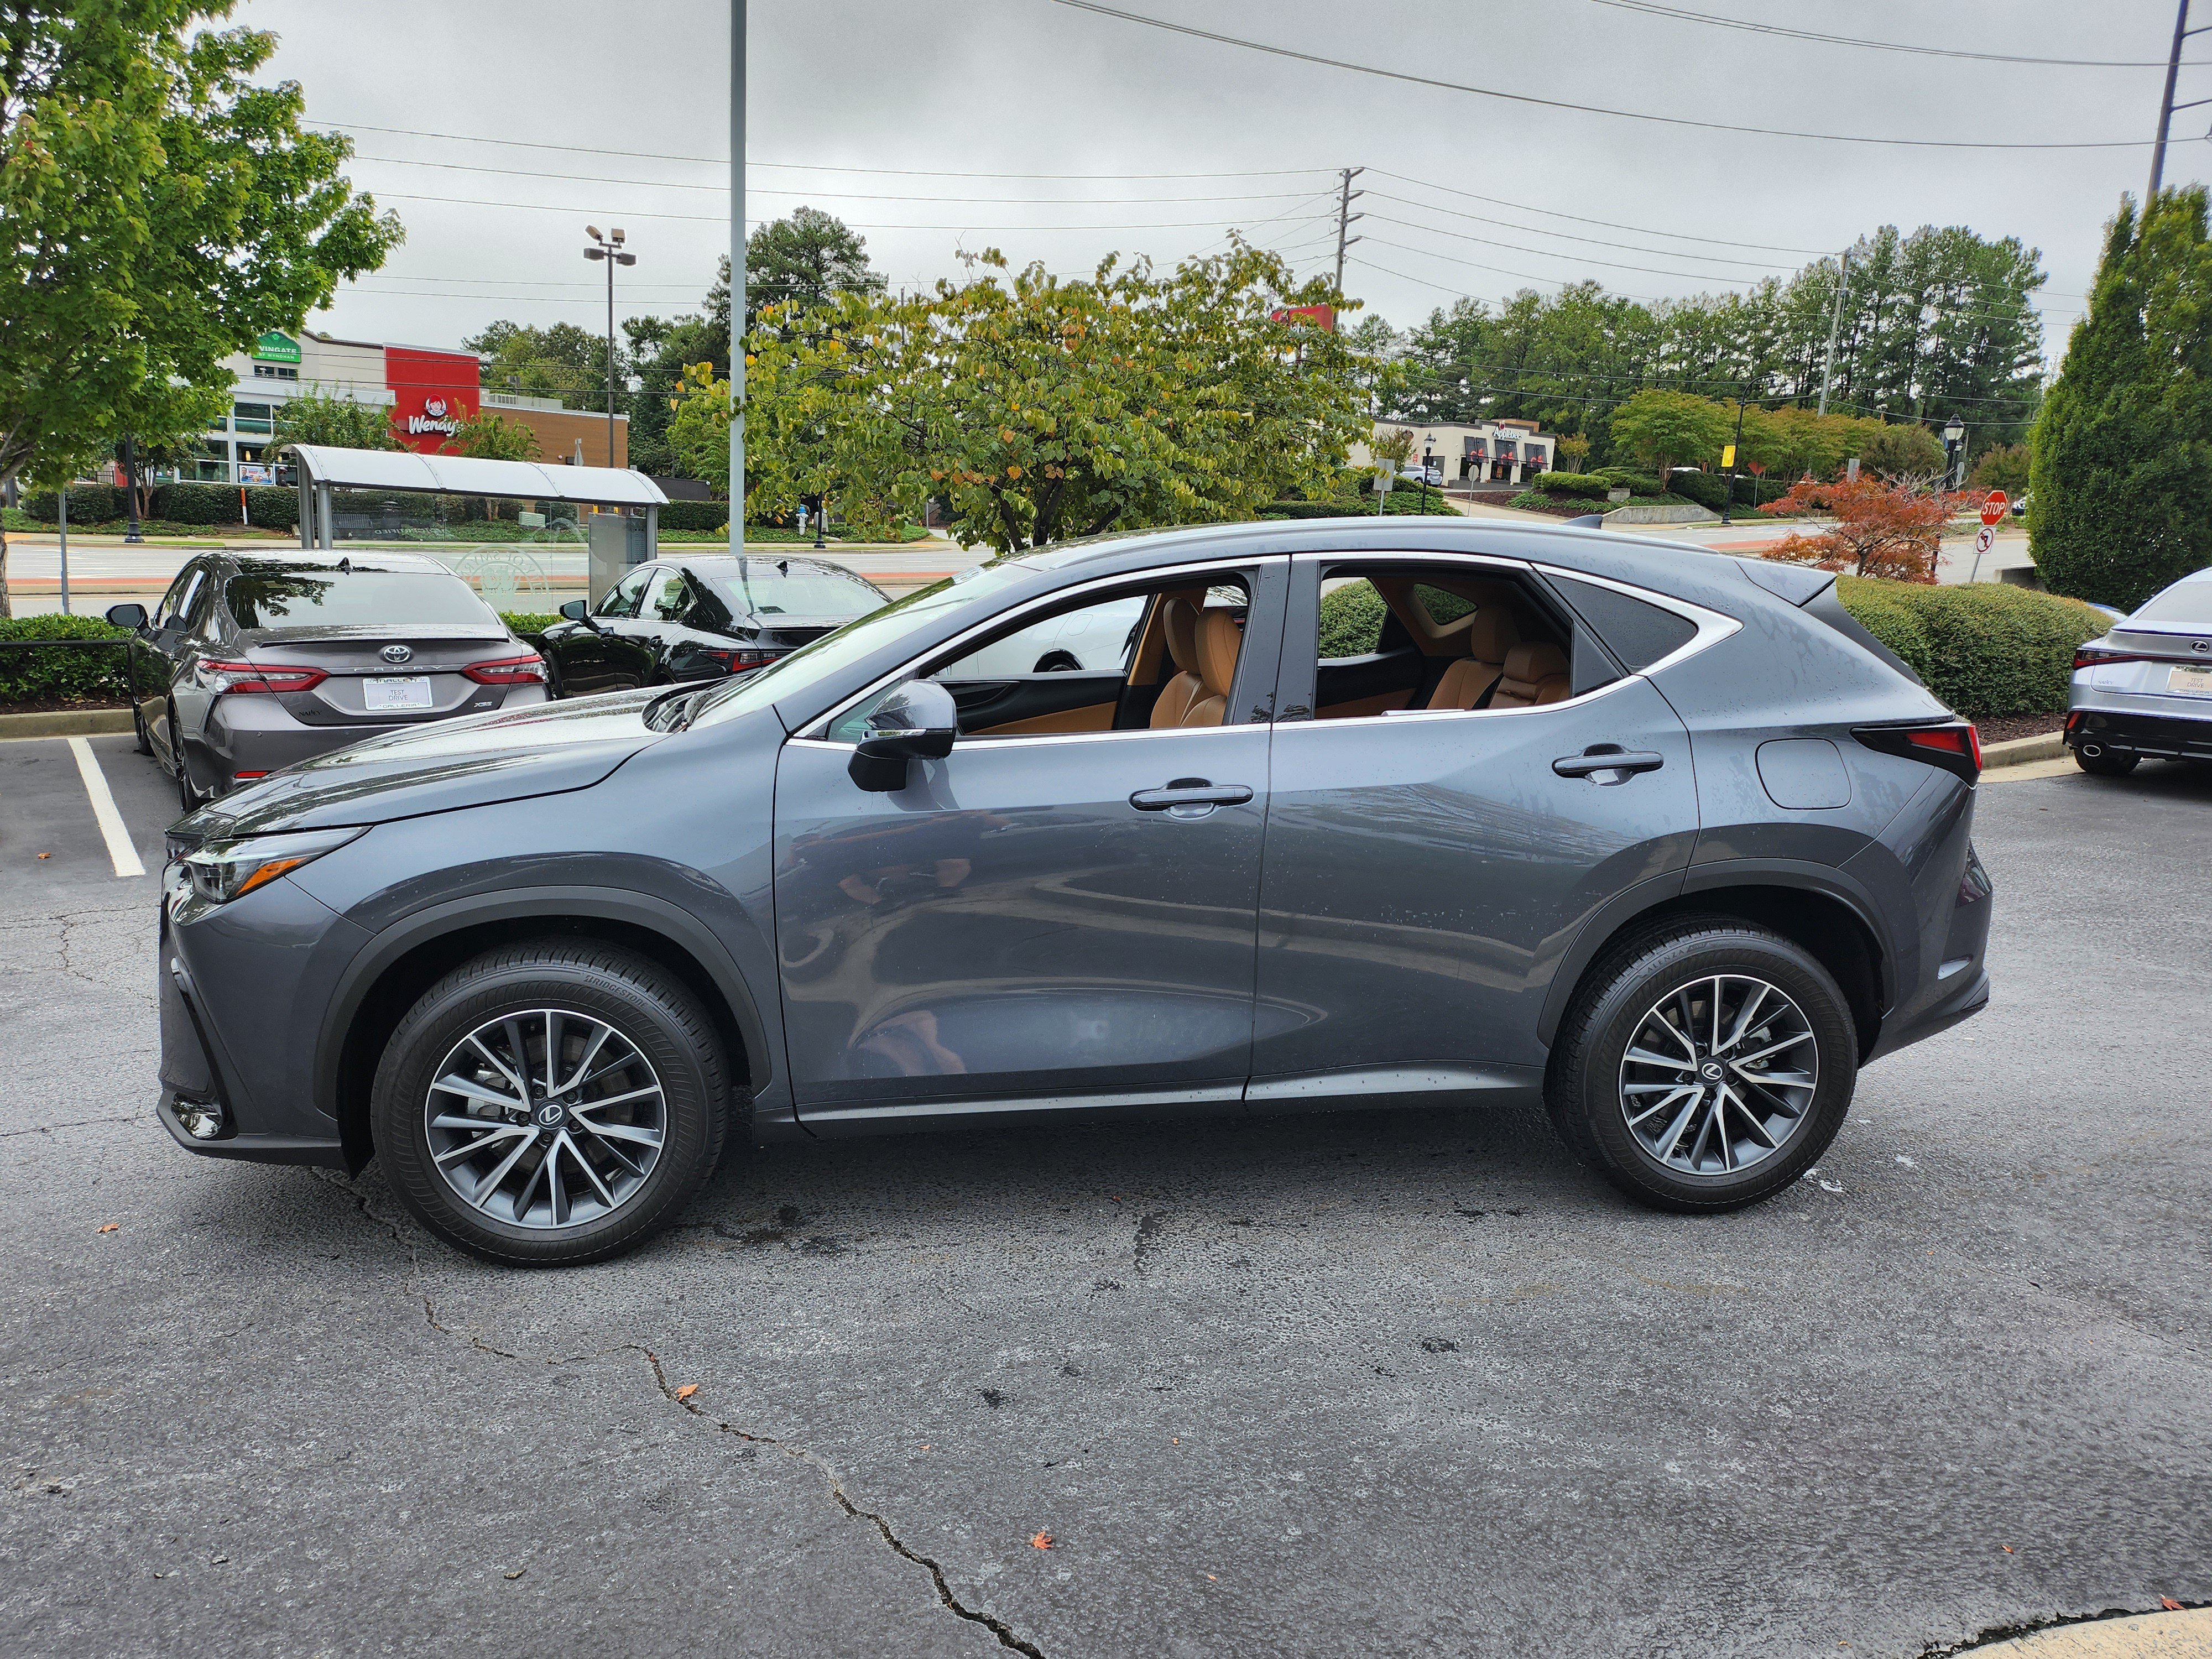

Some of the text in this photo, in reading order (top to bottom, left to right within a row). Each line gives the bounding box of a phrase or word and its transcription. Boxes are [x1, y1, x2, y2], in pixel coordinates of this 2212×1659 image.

[1493, 426, 1522, 440] Applebee's
[1982, 502, 2005, 515] STOP
[1647, 949, 1685, 973] ALENZA
[583, 975, 649, 1009] BRIDGESTONE
